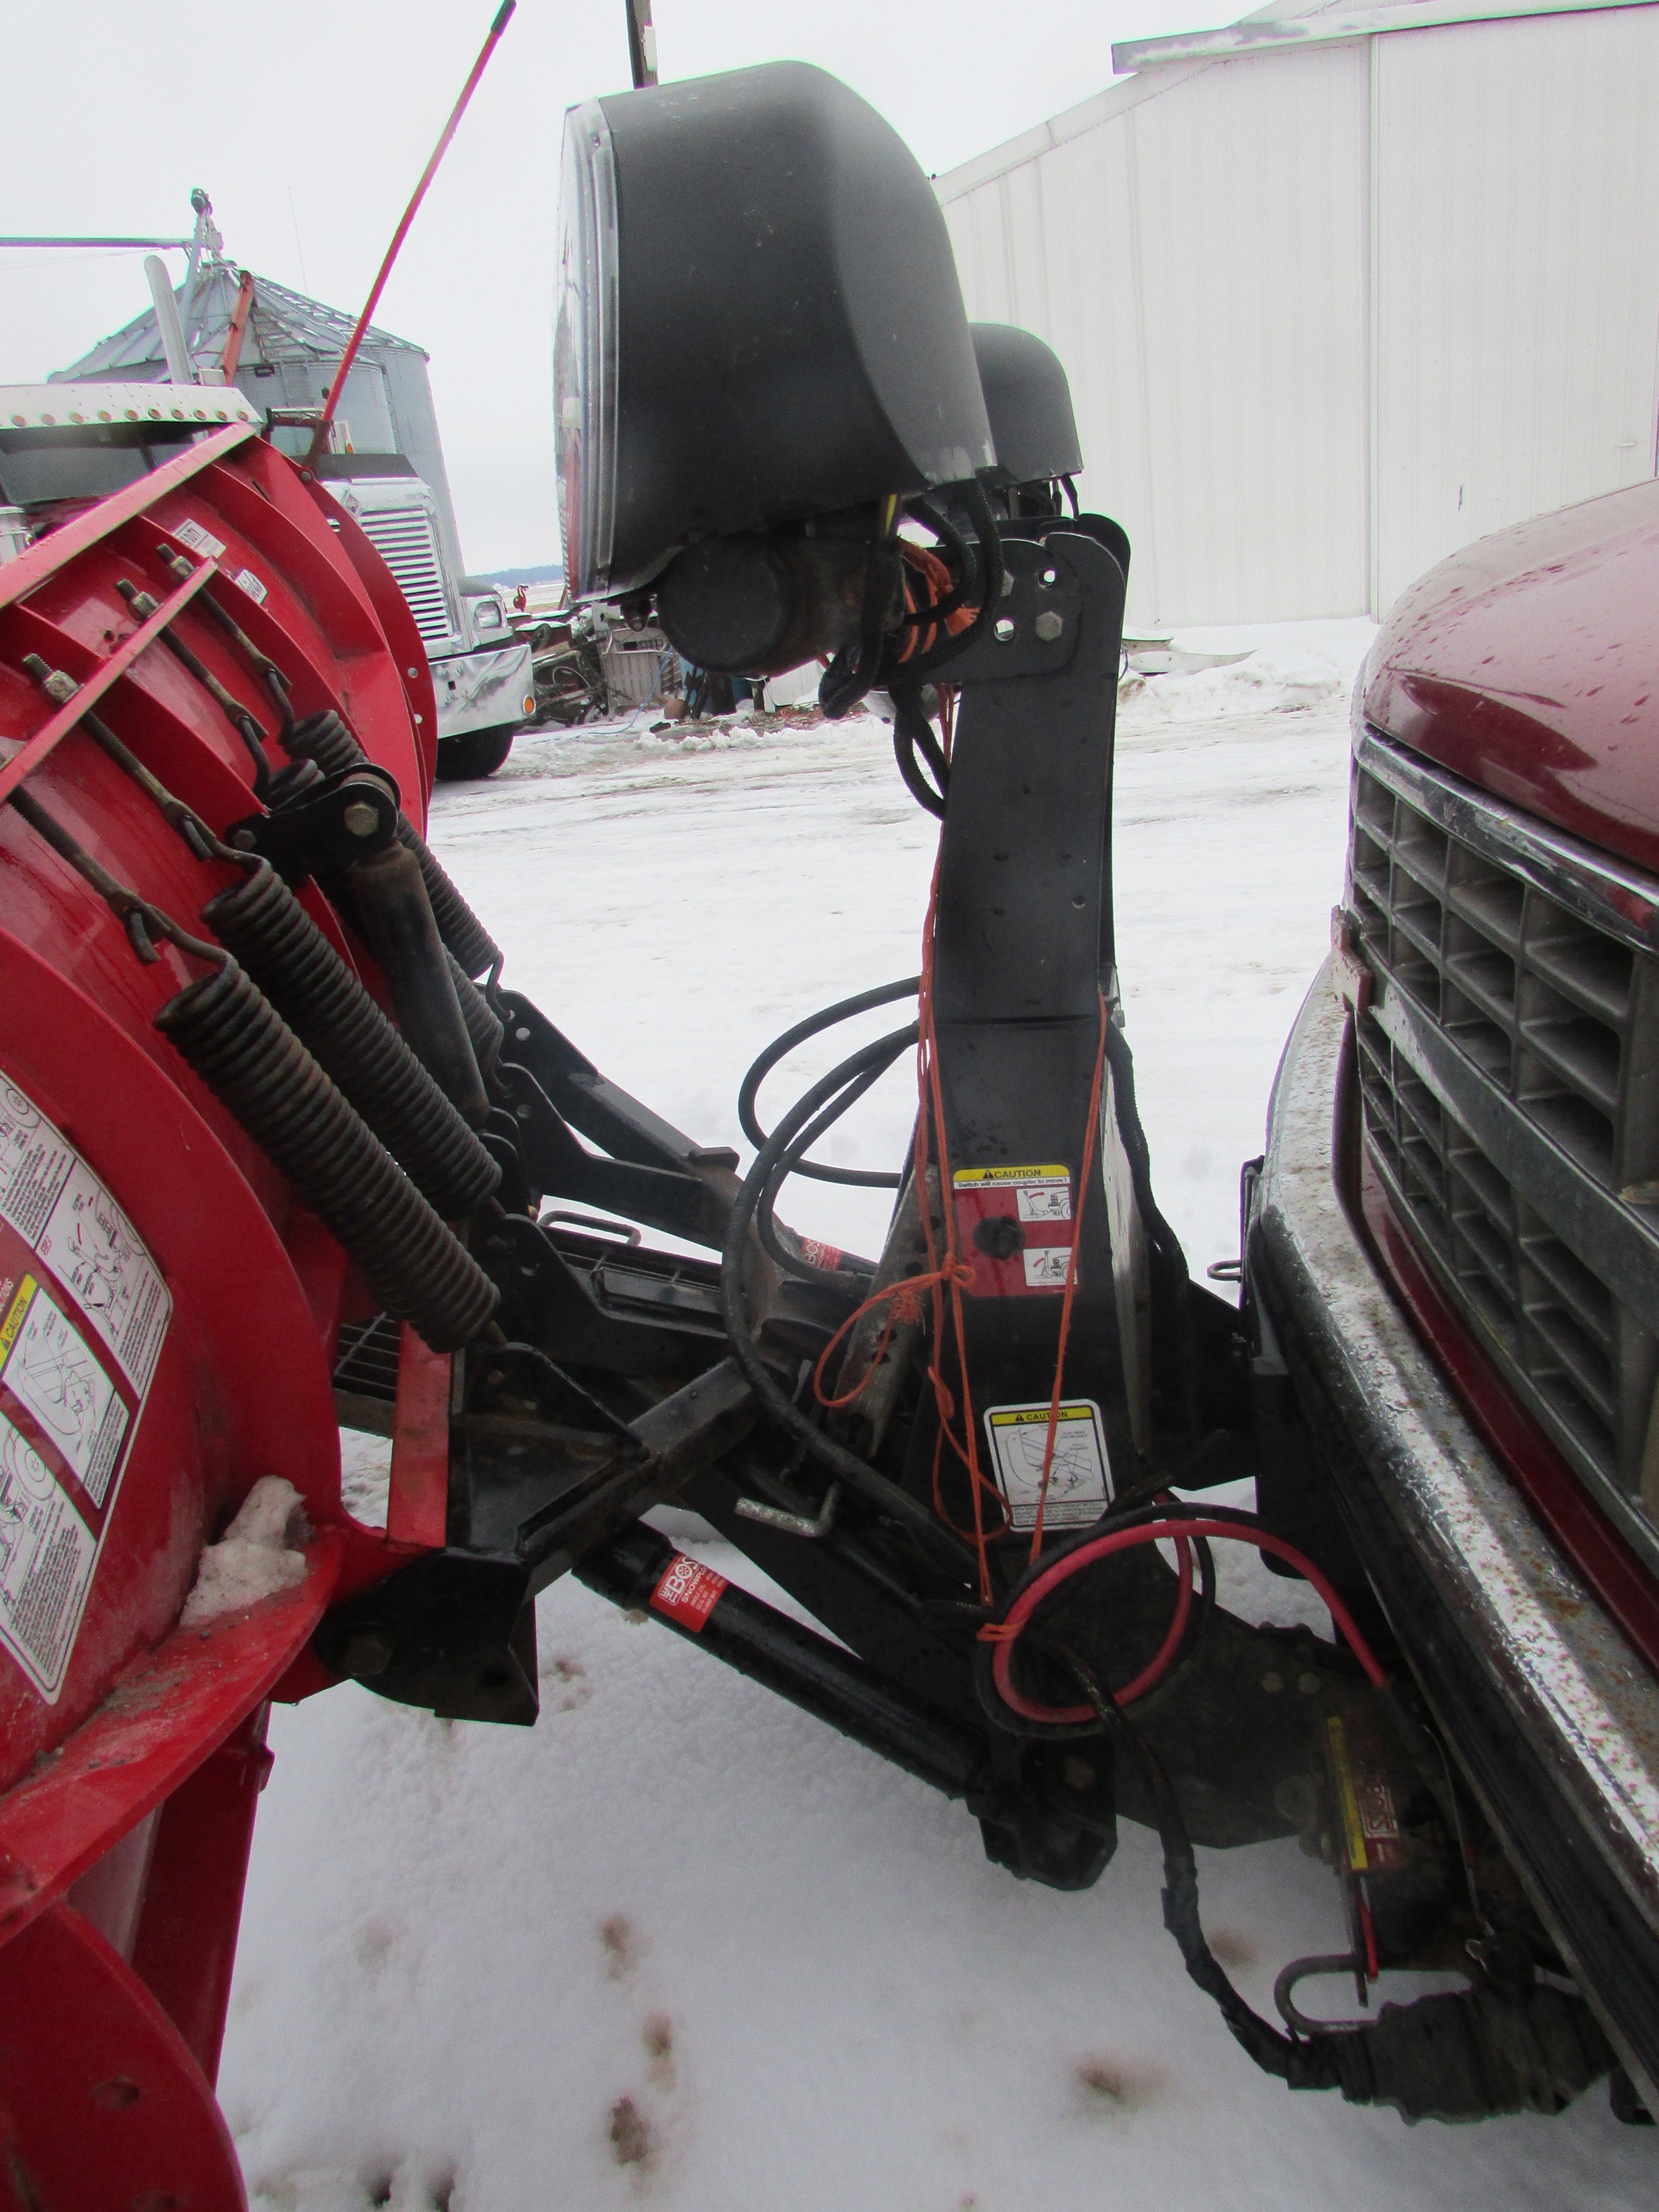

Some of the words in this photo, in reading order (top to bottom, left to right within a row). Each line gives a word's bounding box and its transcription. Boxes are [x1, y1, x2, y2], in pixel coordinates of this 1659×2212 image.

[995, 1169, 1041, 1179] CAUTION
[6, 1295, 27, 1338] CAUTION
[1027, 1411, 1068, 1420] CAUTN
[660, 1586, 678, 1604] THE
